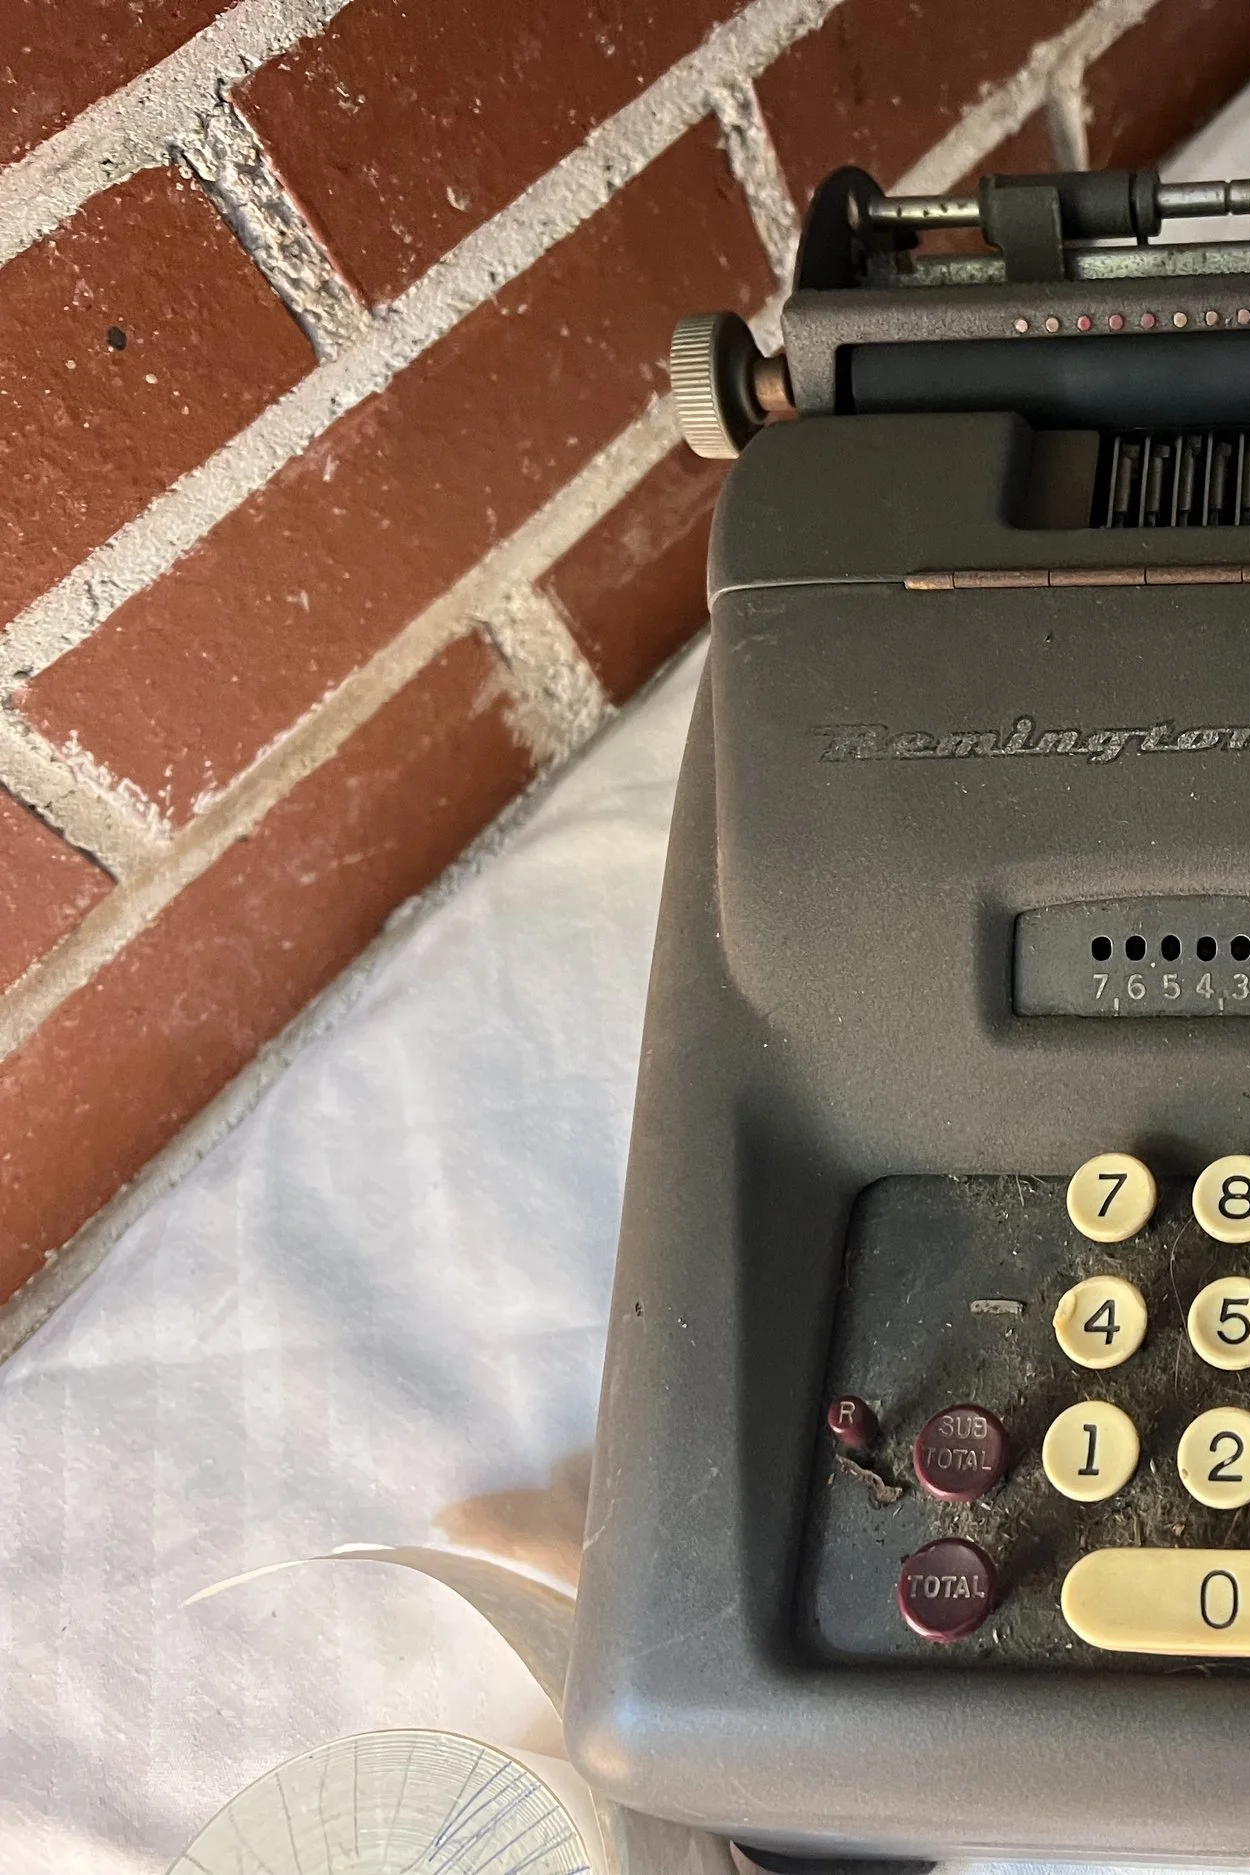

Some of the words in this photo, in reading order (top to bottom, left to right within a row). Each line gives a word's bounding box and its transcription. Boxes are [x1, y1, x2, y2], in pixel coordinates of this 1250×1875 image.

[1092, 973, 1109, 1001] 7
[1127, 973, 1145, 1001] 6
[1163, 973, 1180, 1001] 5
[1196, 973, 1214, 1001] 4
[1232, 973, 1249, 1001] 3
[1098, 1173, 1127, 1217] 7
[1083, 1299, 1120, 1345] 4
[1217, 1298, 1250, 1345] 5
[838, 1401, 856, 1424] R
[938, 1416, 988, 1440] SUB
[923, 1448, 992, 1472] TOTAL
[1077, 1424, 1099, 1476] 1
[1208, 1431, 1243, 1482] 2
[907, 1574, 985, 1599] TOTAL
